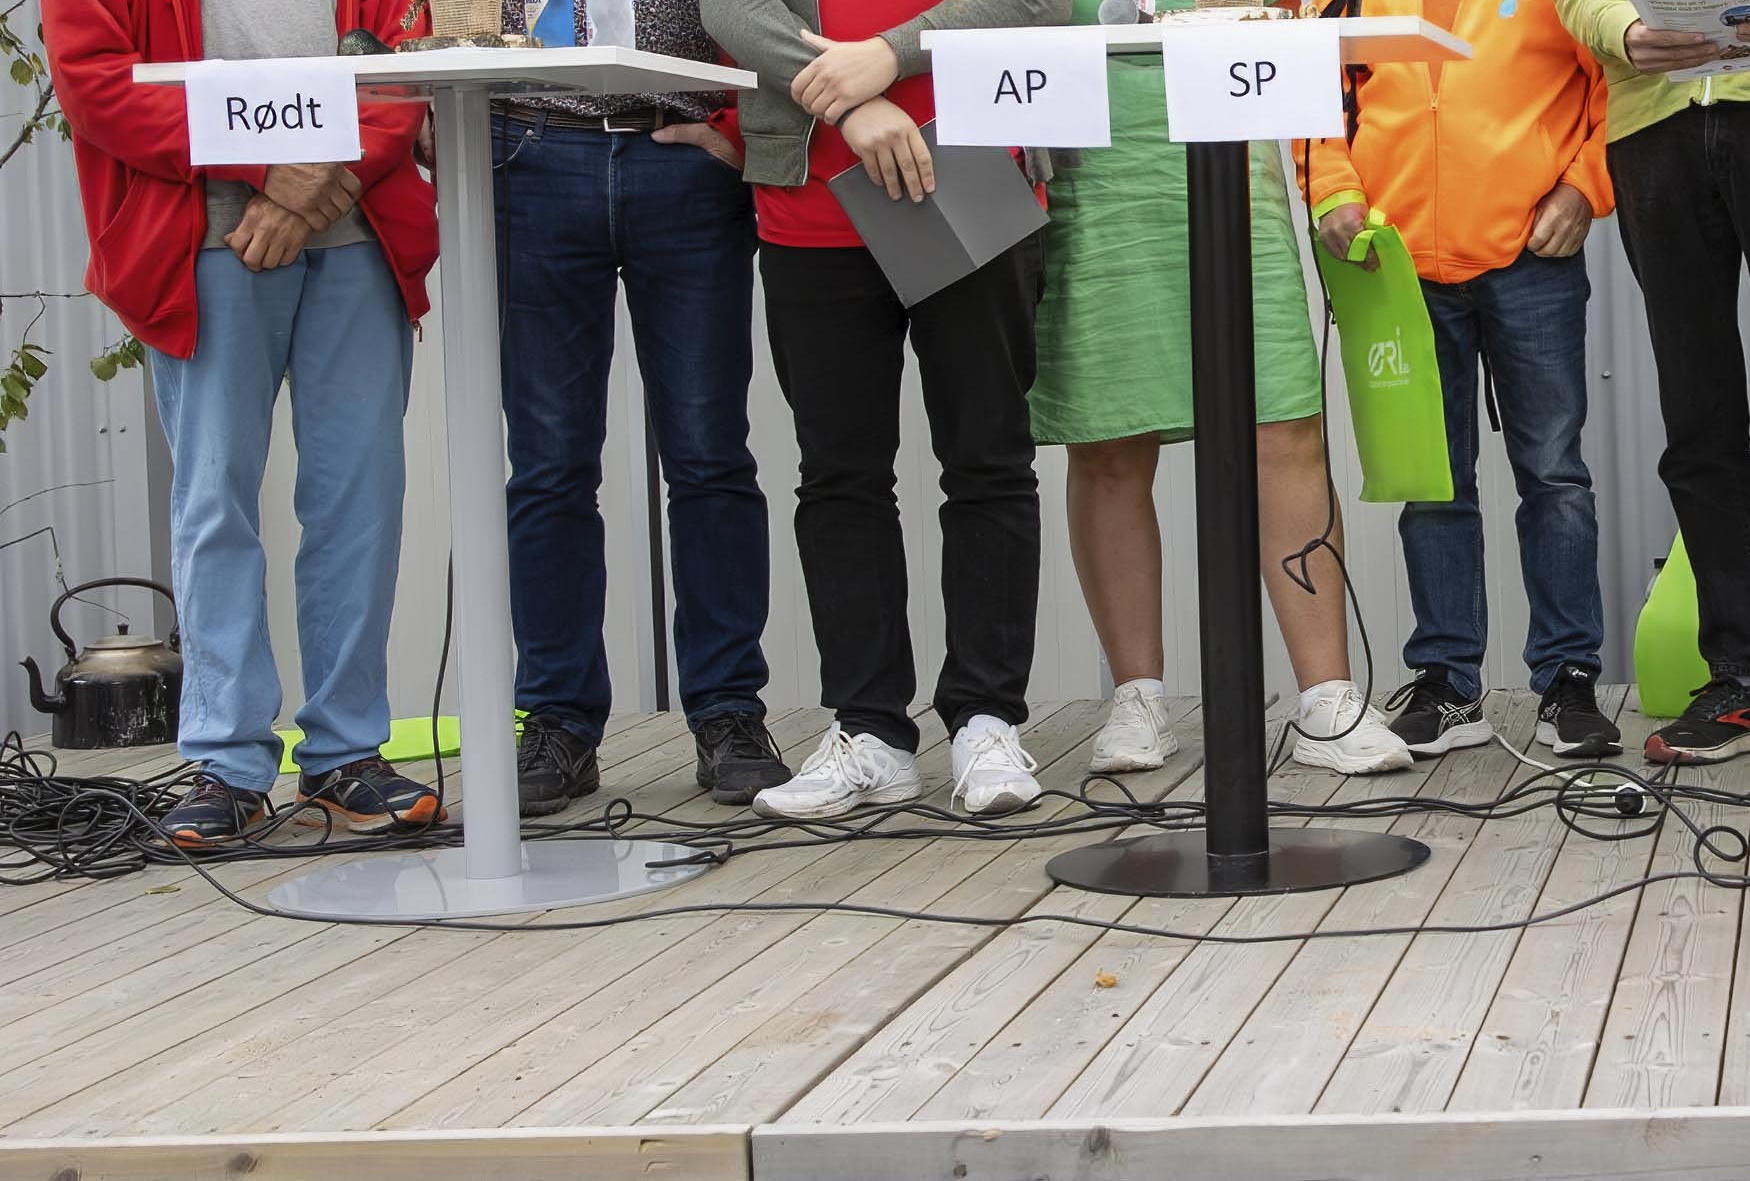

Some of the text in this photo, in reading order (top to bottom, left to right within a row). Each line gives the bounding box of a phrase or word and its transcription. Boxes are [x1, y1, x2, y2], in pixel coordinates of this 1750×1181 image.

[993, 69, 1047, 104] AP
[1229, 61, 1277, 98] SP
[226, 92, 324, 135] Rødt
